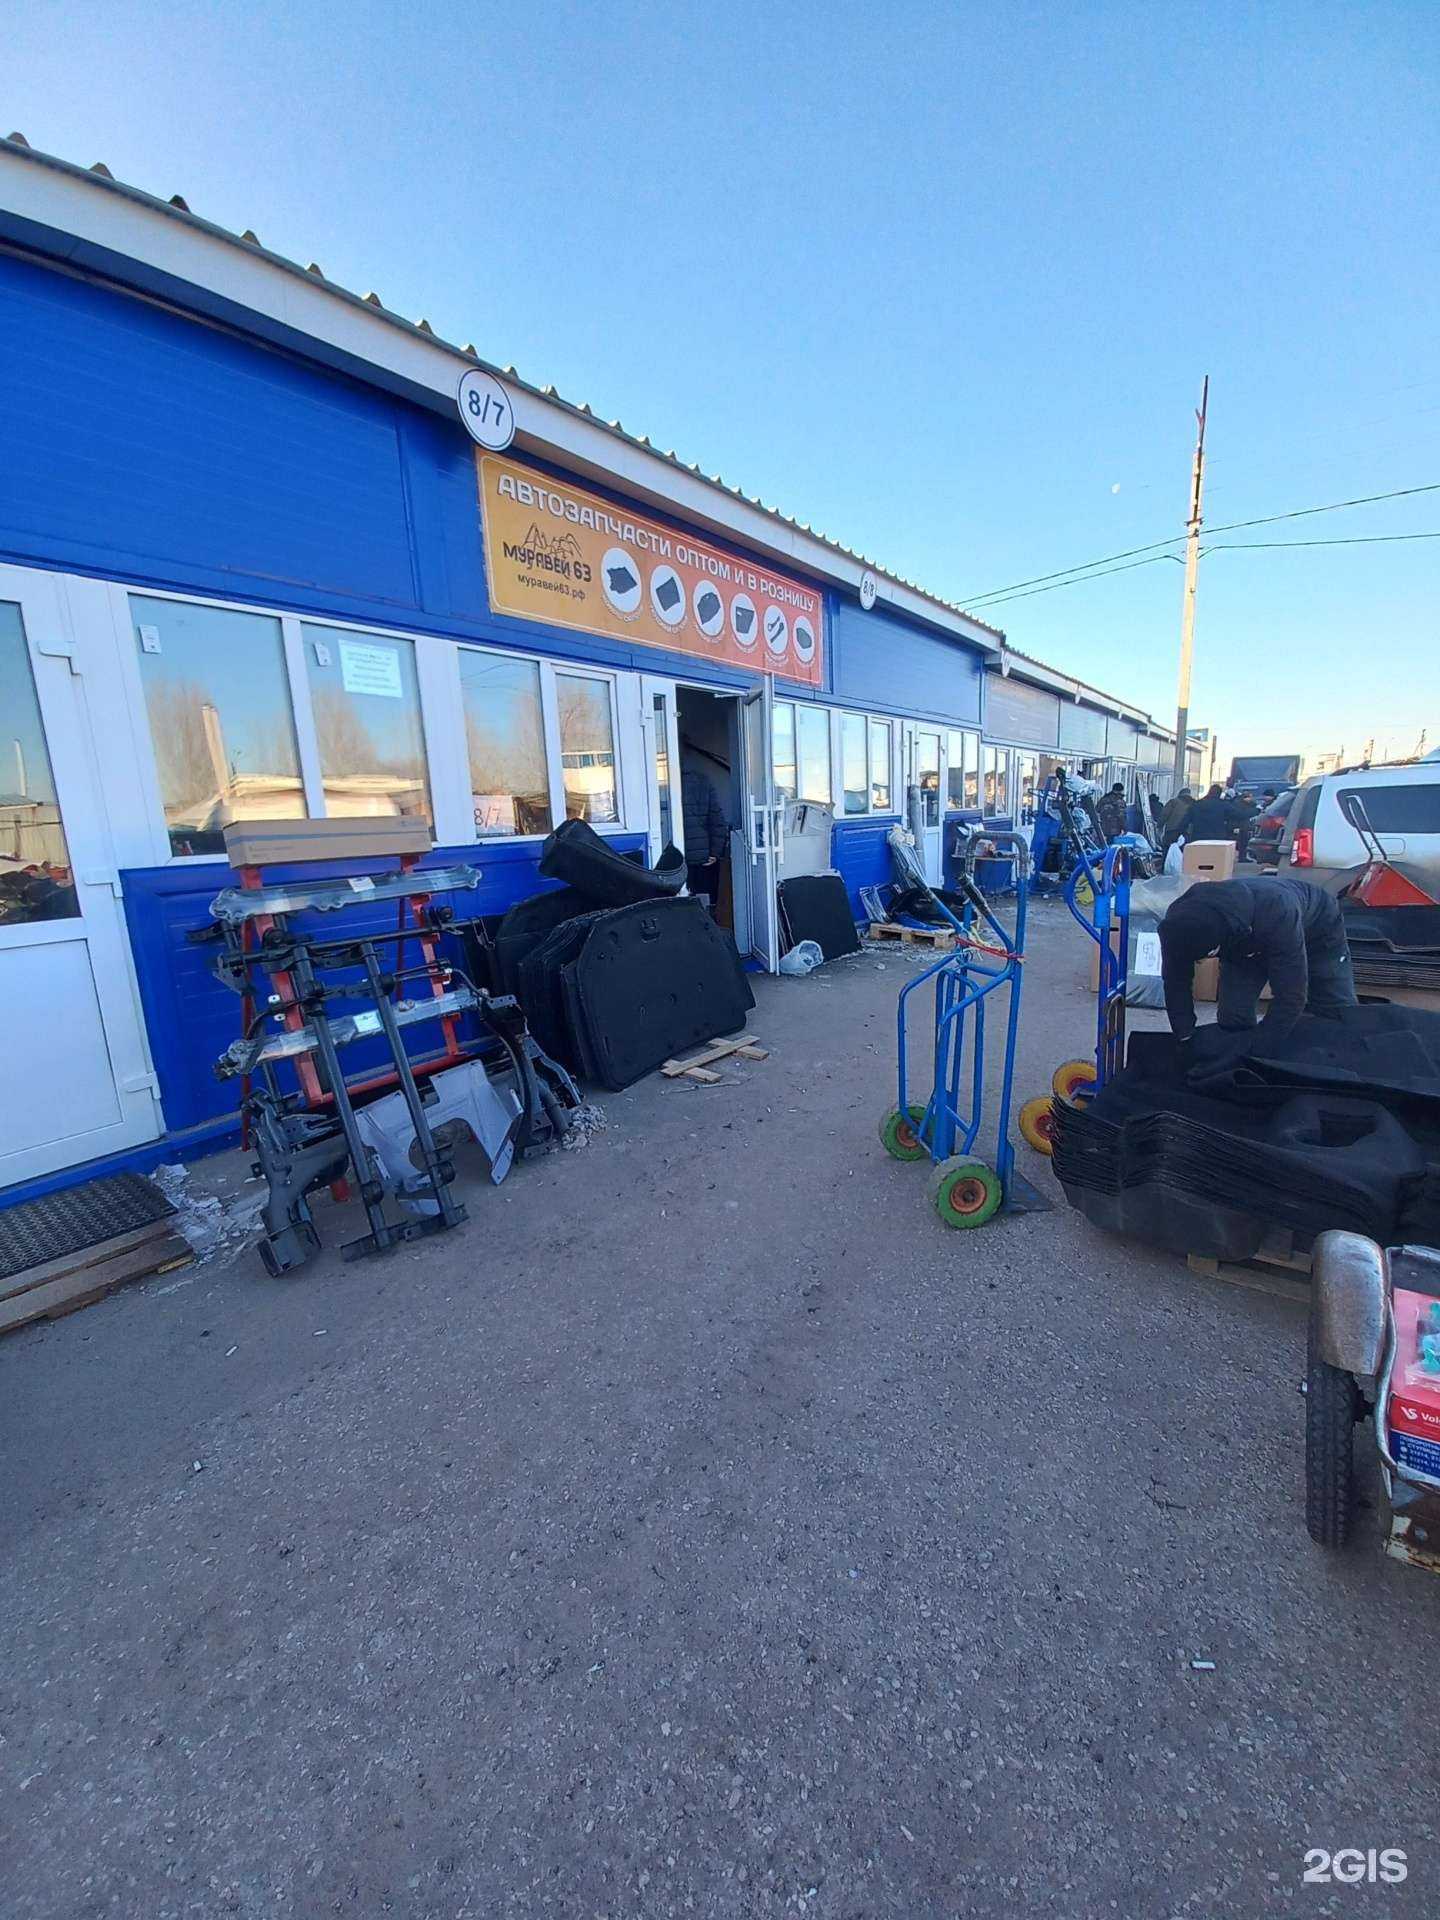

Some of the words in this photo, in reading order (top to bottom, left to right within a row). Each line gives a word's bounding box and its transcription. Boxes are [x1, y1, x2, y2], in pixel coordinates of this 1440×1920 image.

[469, 389, 505, 427] 8/7
[498, 473, 672, 559] АВТОЗАПЧАСТИ
[675, 544, 731, 581] ОПТОМ
[734, 567, 744, 586] И
[747, 573, 757, 591] В
[760, 578, 815, 613] РОЗНИЦУ
[573, 560, 592, 583] 63
[517, 574, 586, 602] муравей63.рф
[474, 807, 502, 829] 8/7
[1421, 1412, 1440, 1425] Vol
